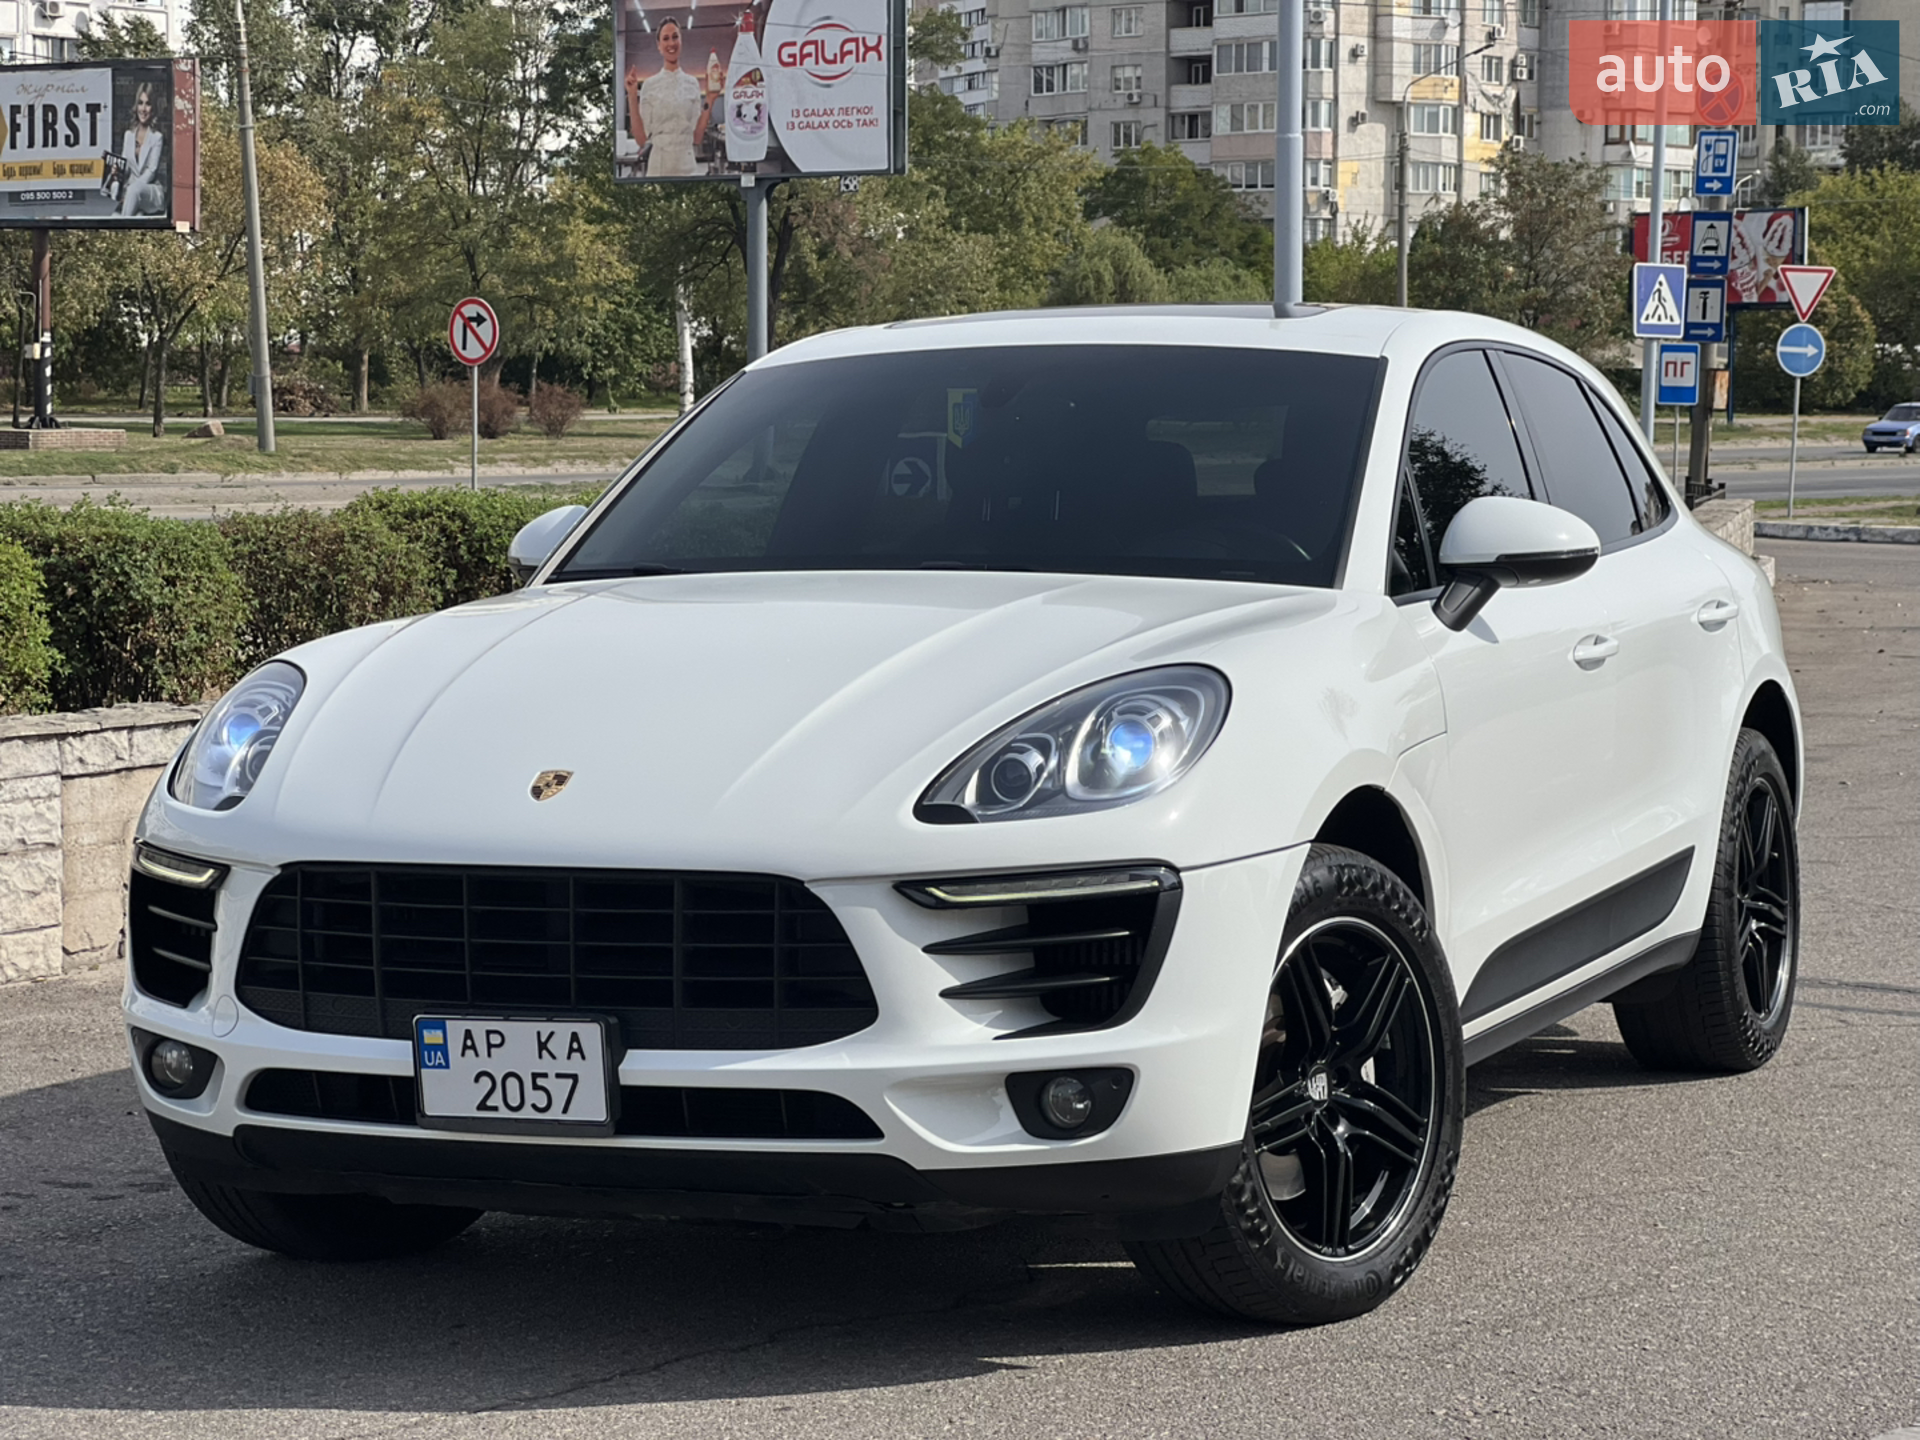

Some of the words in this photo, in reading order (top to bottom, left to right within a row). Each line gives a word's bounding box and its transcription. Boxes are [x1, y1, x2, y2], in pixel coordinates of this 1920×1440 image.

[777, 35, 883, 68] GALAX
[733, 90, 764, 99] GALAX
[803, 107, 835, 118] GALAX
[837, 105, 874, 117] ЛЕГКО!
[9, 102, 101, 150] FIRST
[797, 120, 830, 131] GALAX
[832, 119, 854, 129] ОСЬ
[856, 118, 879, 128] ТАК!
[1714, 158, 1726, 168] EV
[68, 190, 74, 199] 2
[1665, 361, 1691, 378] ПГ
[461, 1028, 505, 1058] AP
[536, 1030, 586, 1061] KA
[424, 1051, 446, 1067] UA
[473, 1070, 579, 1115] 2057
